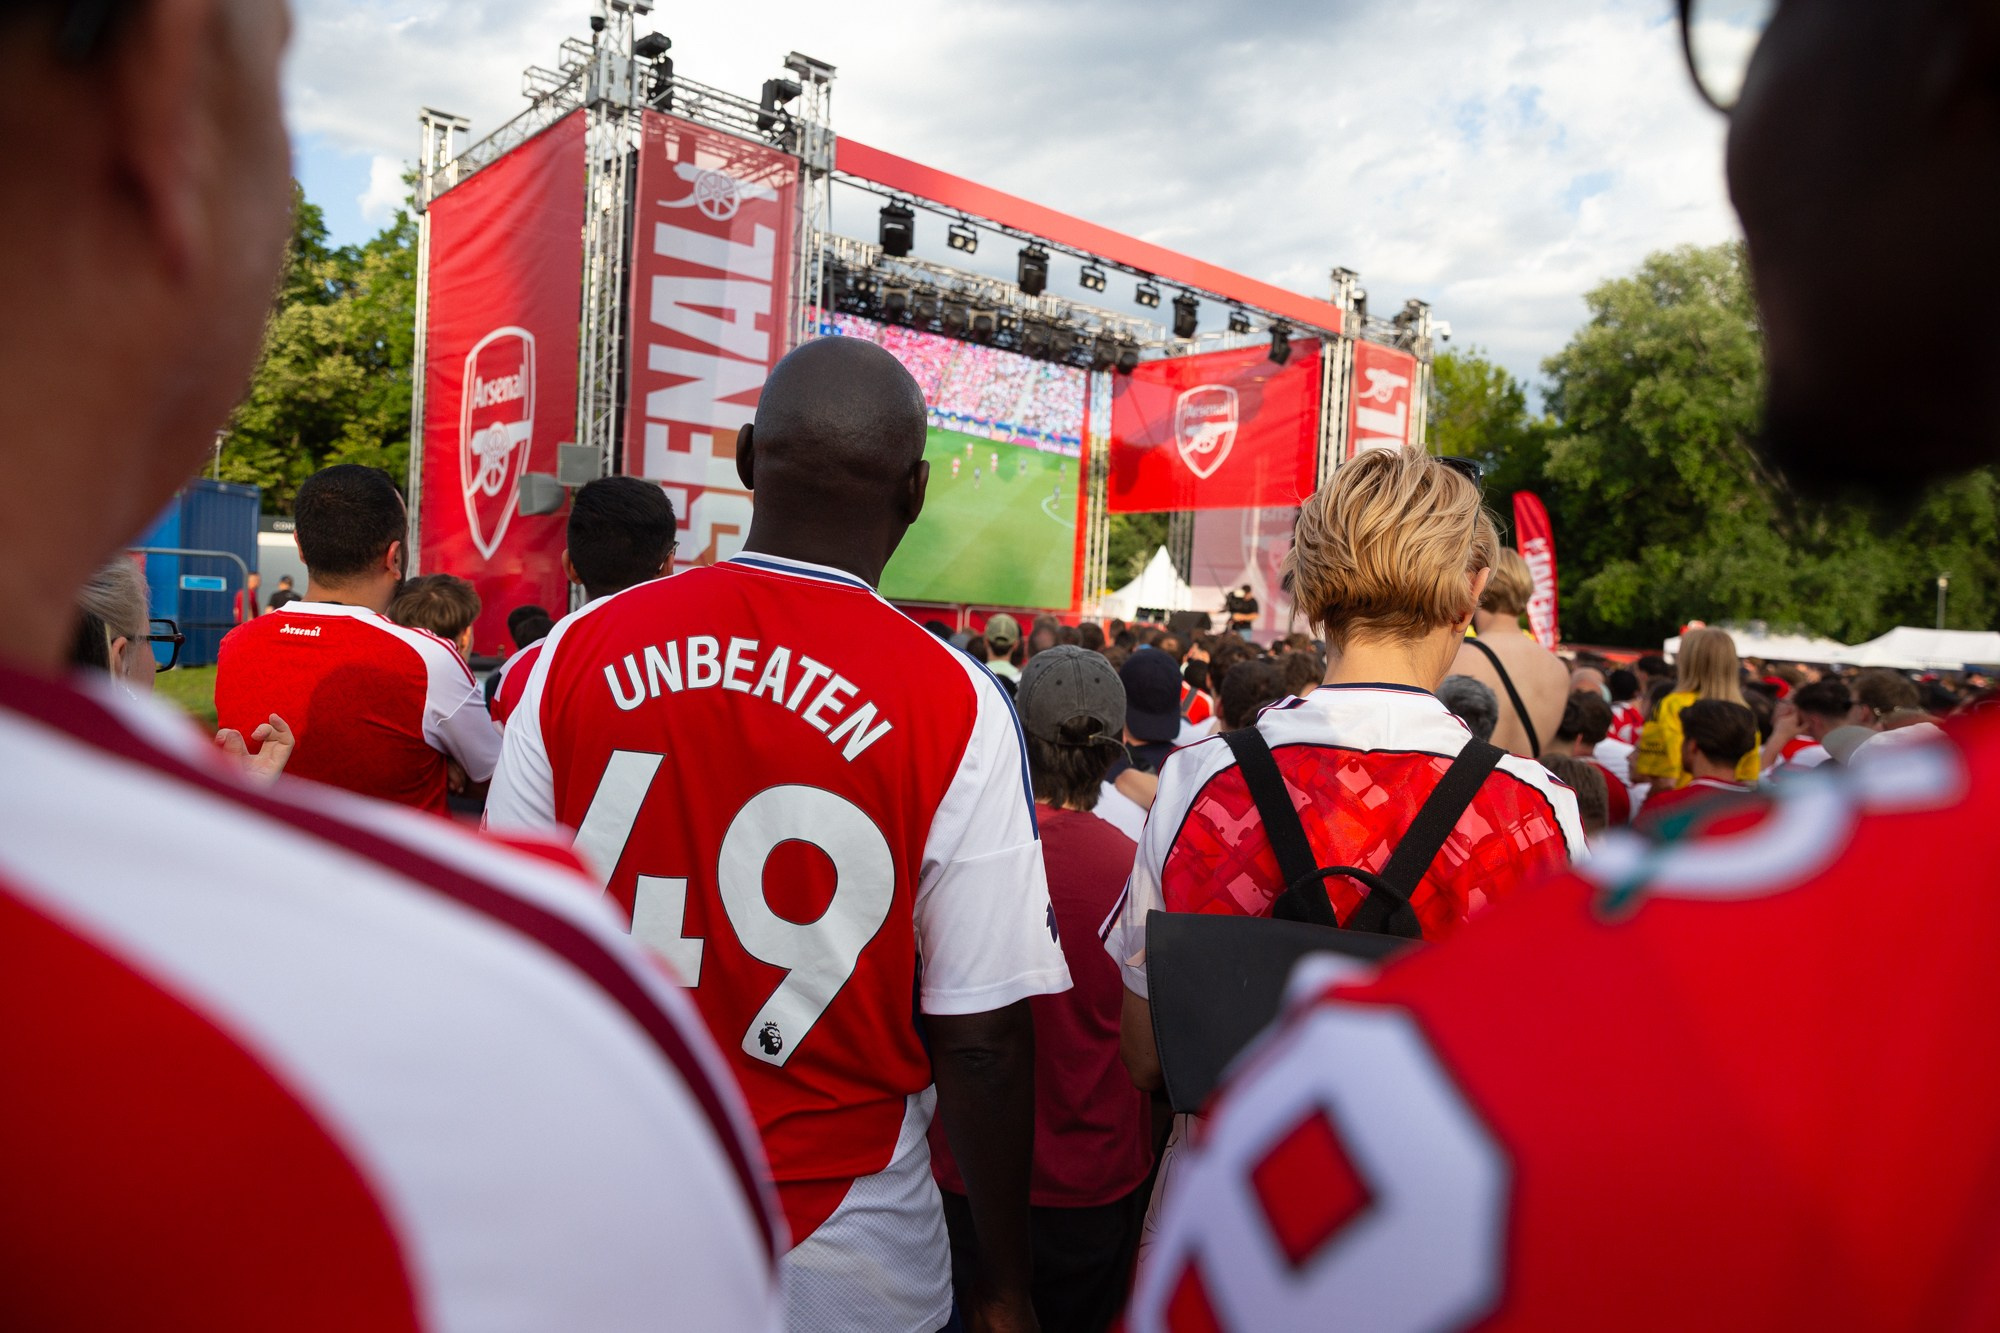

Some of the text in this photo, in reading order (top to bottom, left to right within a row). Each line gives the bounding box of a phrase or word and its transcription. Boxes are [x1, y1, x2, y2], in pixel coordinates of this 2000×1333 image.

[473, 364, 526, 410] Arsenal
[644, 221, 777, 565] SENAL
[280, 623, 321, 637] Arsenal
[603, 635, 894, 762] UNBEATEN
[570, 748, 896, 1068] 49
